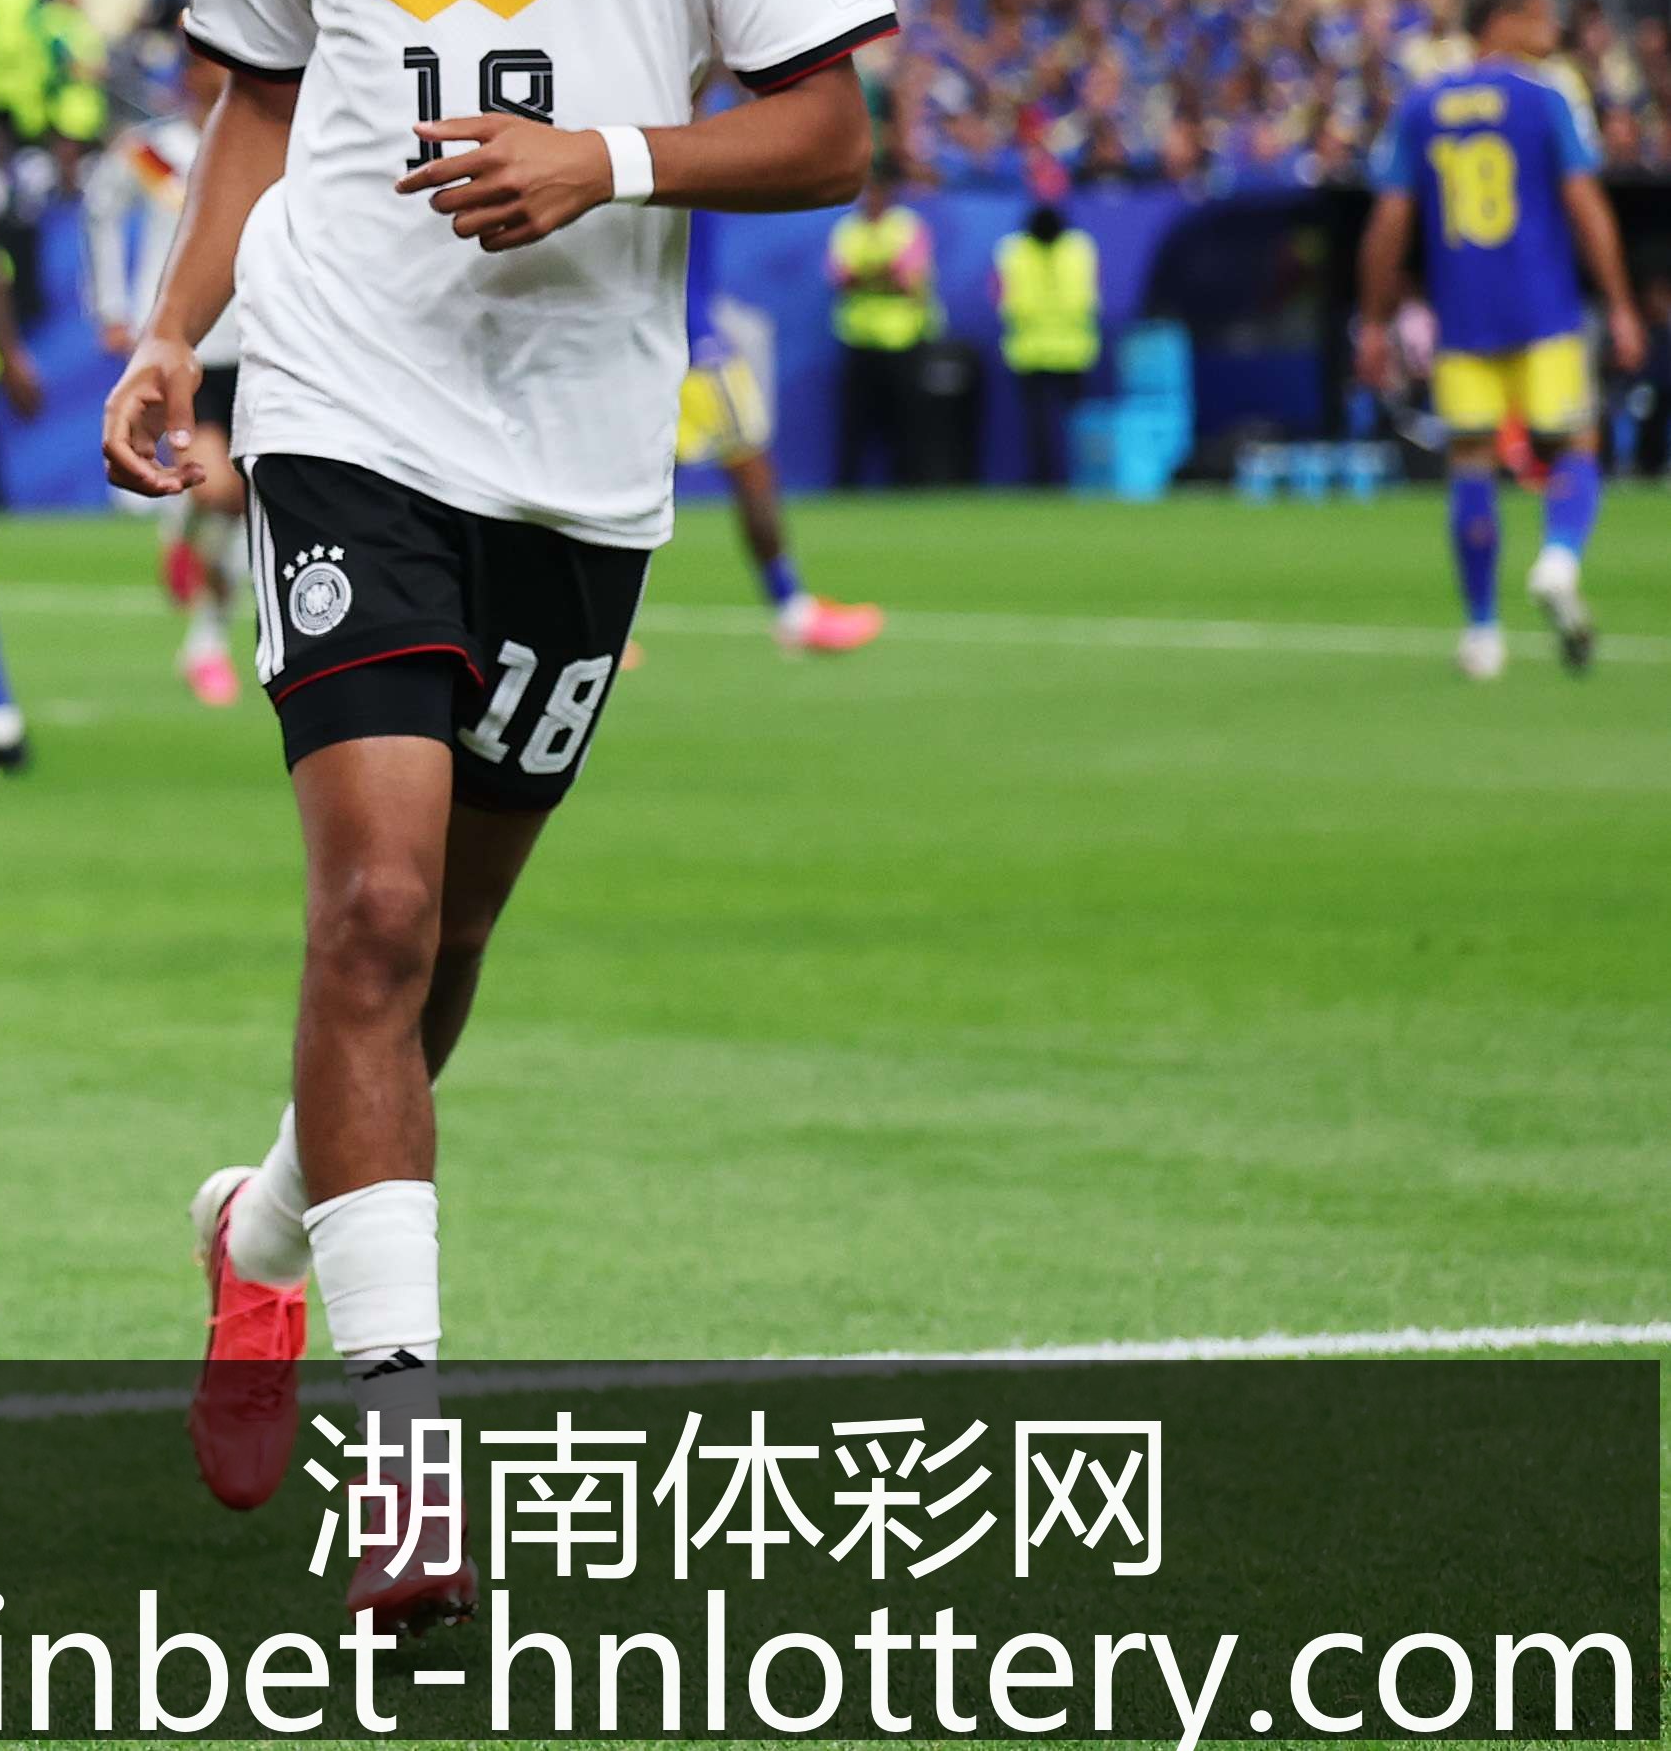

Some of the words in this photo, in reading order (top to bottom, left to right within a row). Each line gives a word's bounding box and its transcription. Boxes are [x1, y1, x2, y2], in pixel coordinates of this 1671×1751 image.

[403, 45, 554, 171] 18
[1426, 132, 1519, 249] 18
[457, 638, 614, 775] 18
